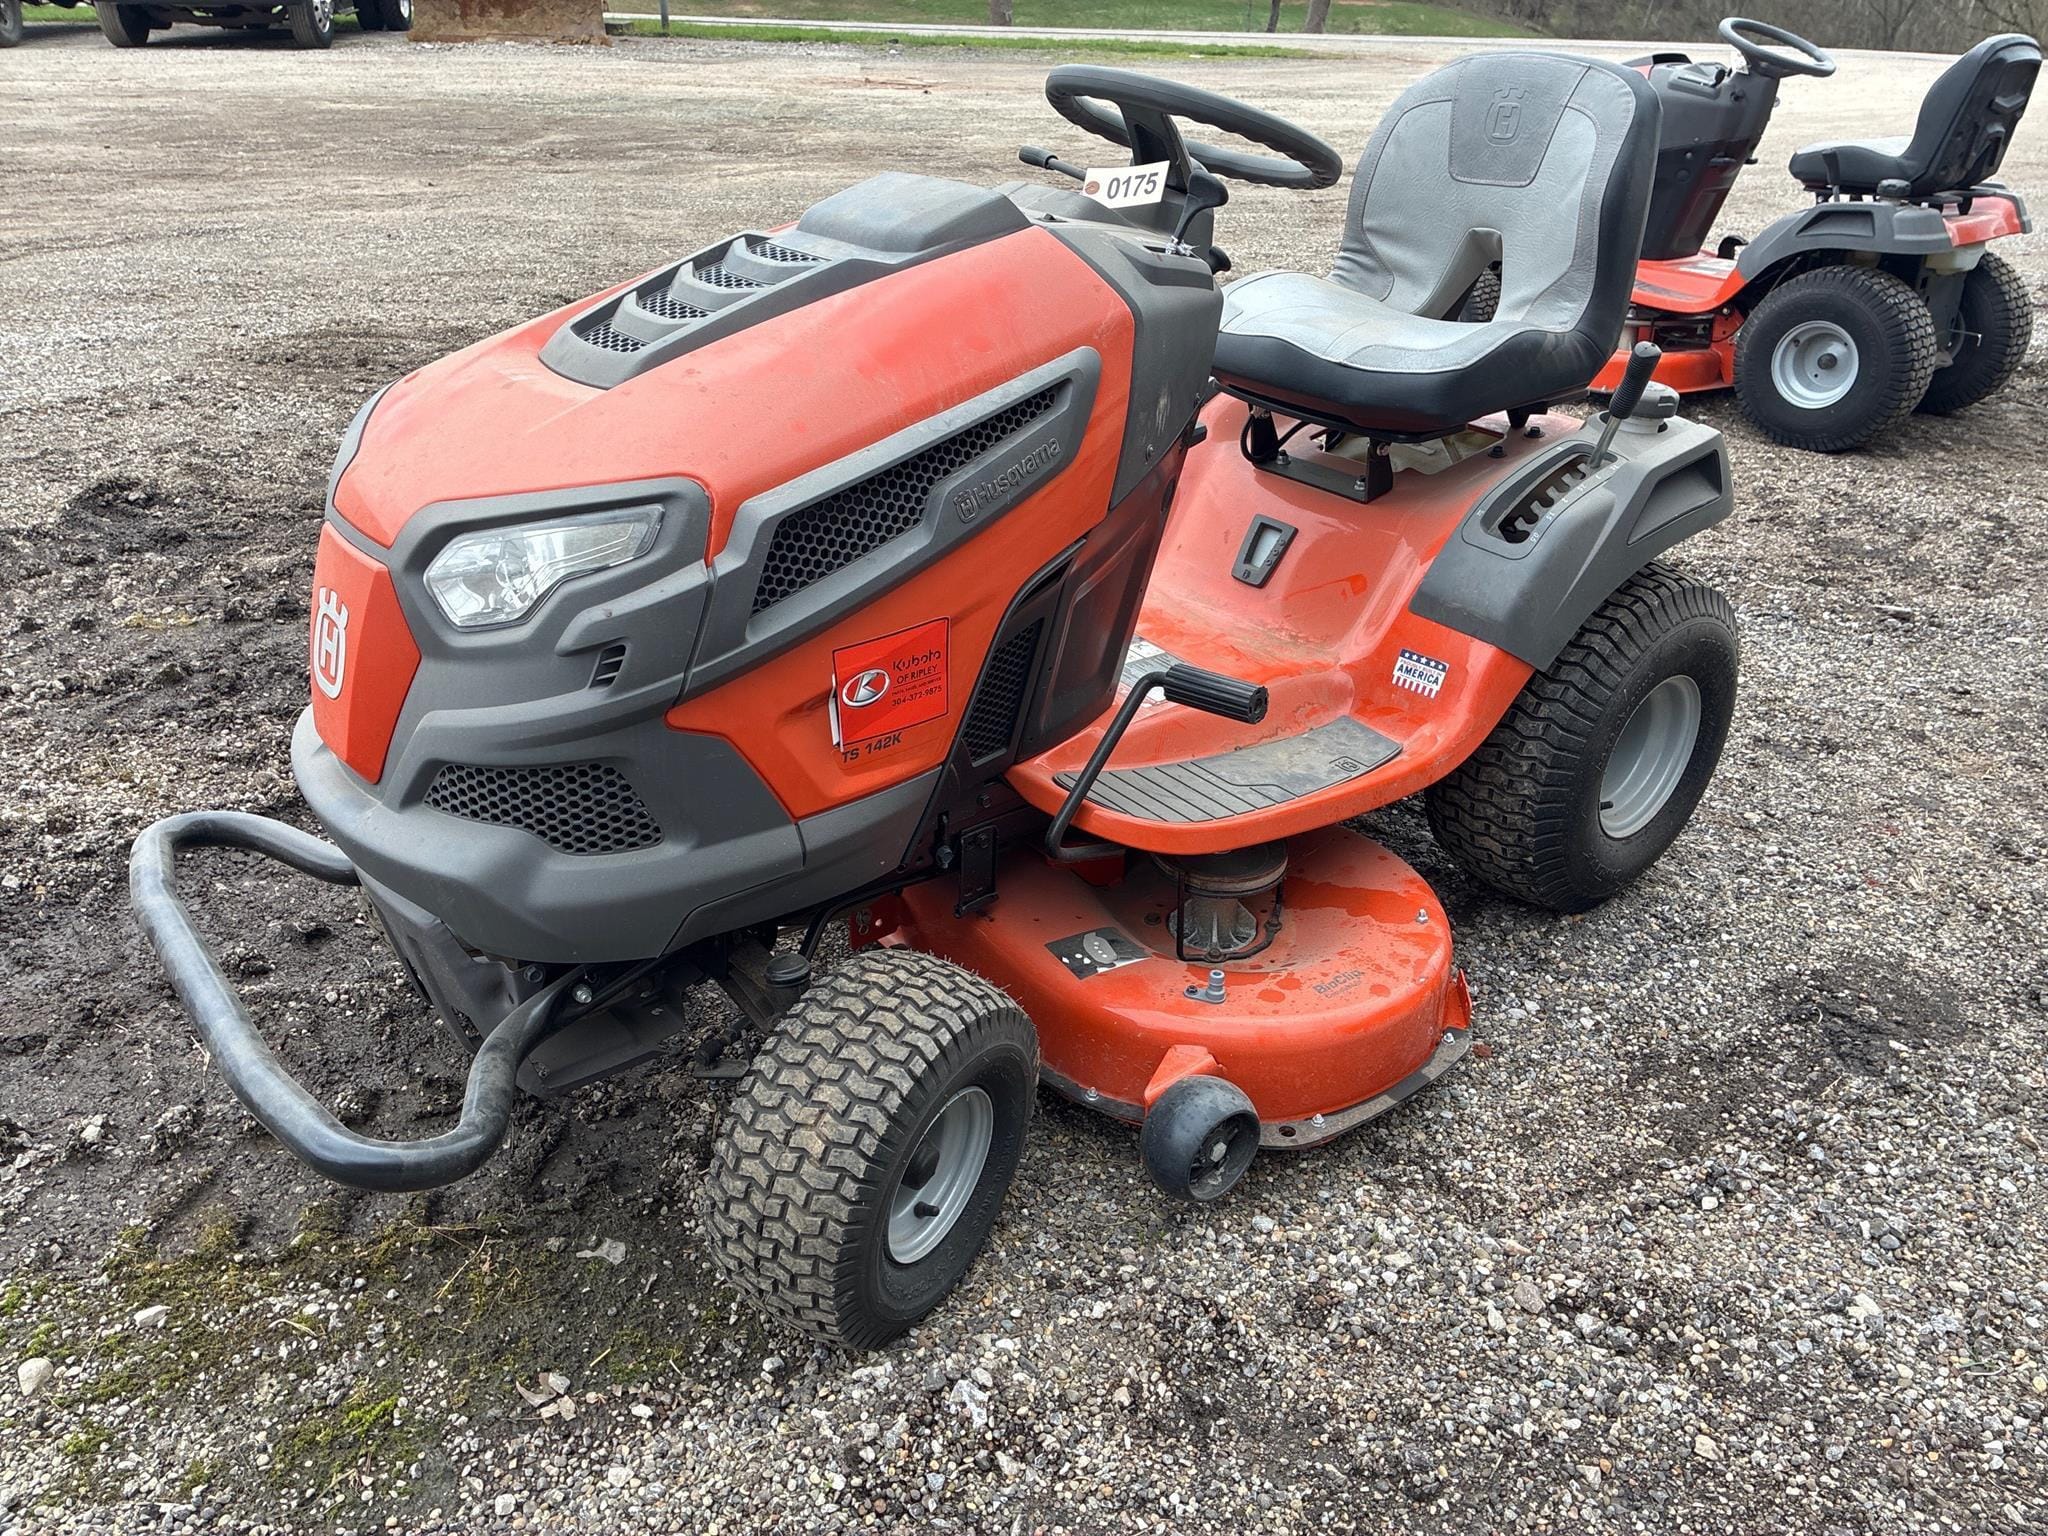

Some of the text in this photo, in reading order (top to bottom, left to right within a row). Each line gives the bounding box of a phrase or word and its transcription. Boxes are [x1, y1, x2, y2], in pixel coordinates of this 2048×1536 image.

[1107, 172, 1159, 200] 0175
[973, 437, 1061, 510] Husqvarna
[893, 649, 941, 671] Kubota
[896, 663, 938, 684] OF RIPLEY
[1396, 663, 1439, 686] AMERICA
[841, 732, 903, 763] TS 142K
